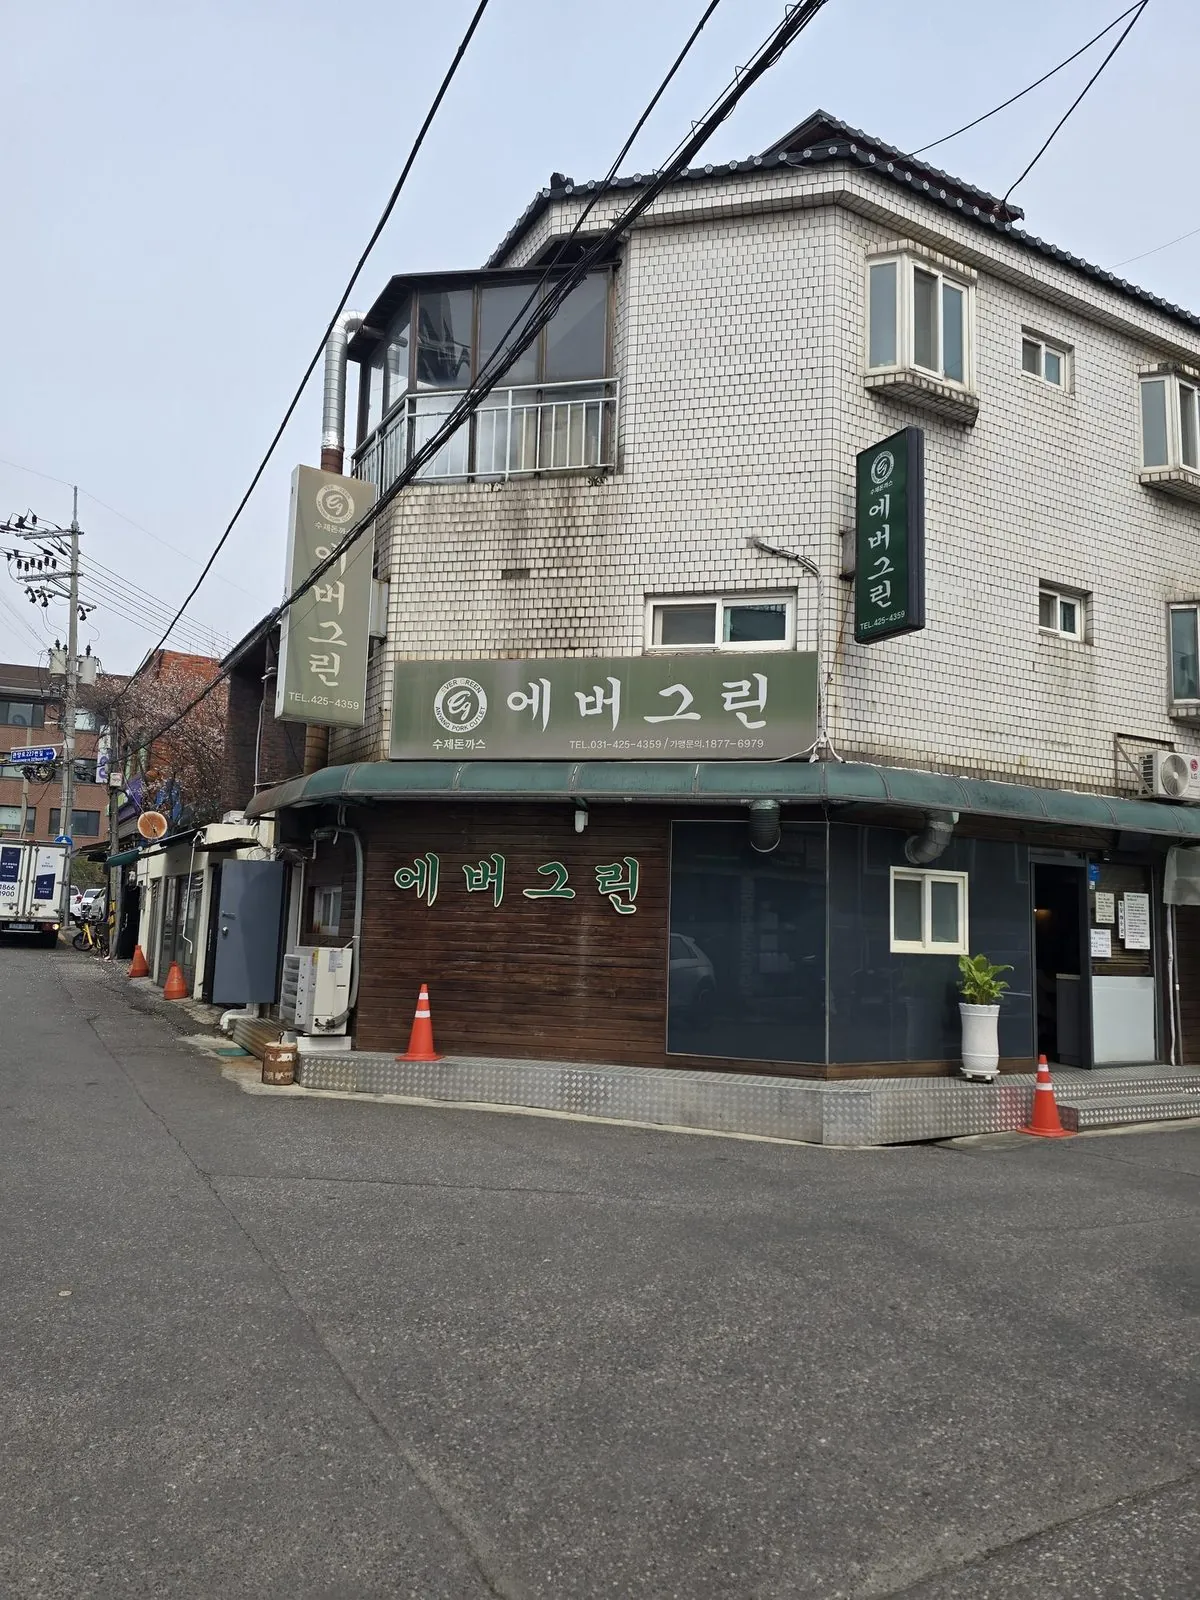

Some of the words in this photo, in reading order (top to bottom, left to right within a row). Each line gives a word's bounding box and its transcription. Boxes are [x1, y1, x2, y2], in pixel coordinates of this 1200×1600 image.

[314, 521, 350, 535] 수제돈까
[867, 494, 894, 608] 에버그린
[859, 611, 905, 630] TEL.425-4359
[288, 691, 359, 711] TEL.425-4359
[507, 673, 768, 732] 에버그린
[435, 706, 450, 728] ANYANG
[469, 706, 486, 727] CUTLET
[432, 738, 486, 750] 수제돈까스
[394, 852, 640, 915] 에버그린
